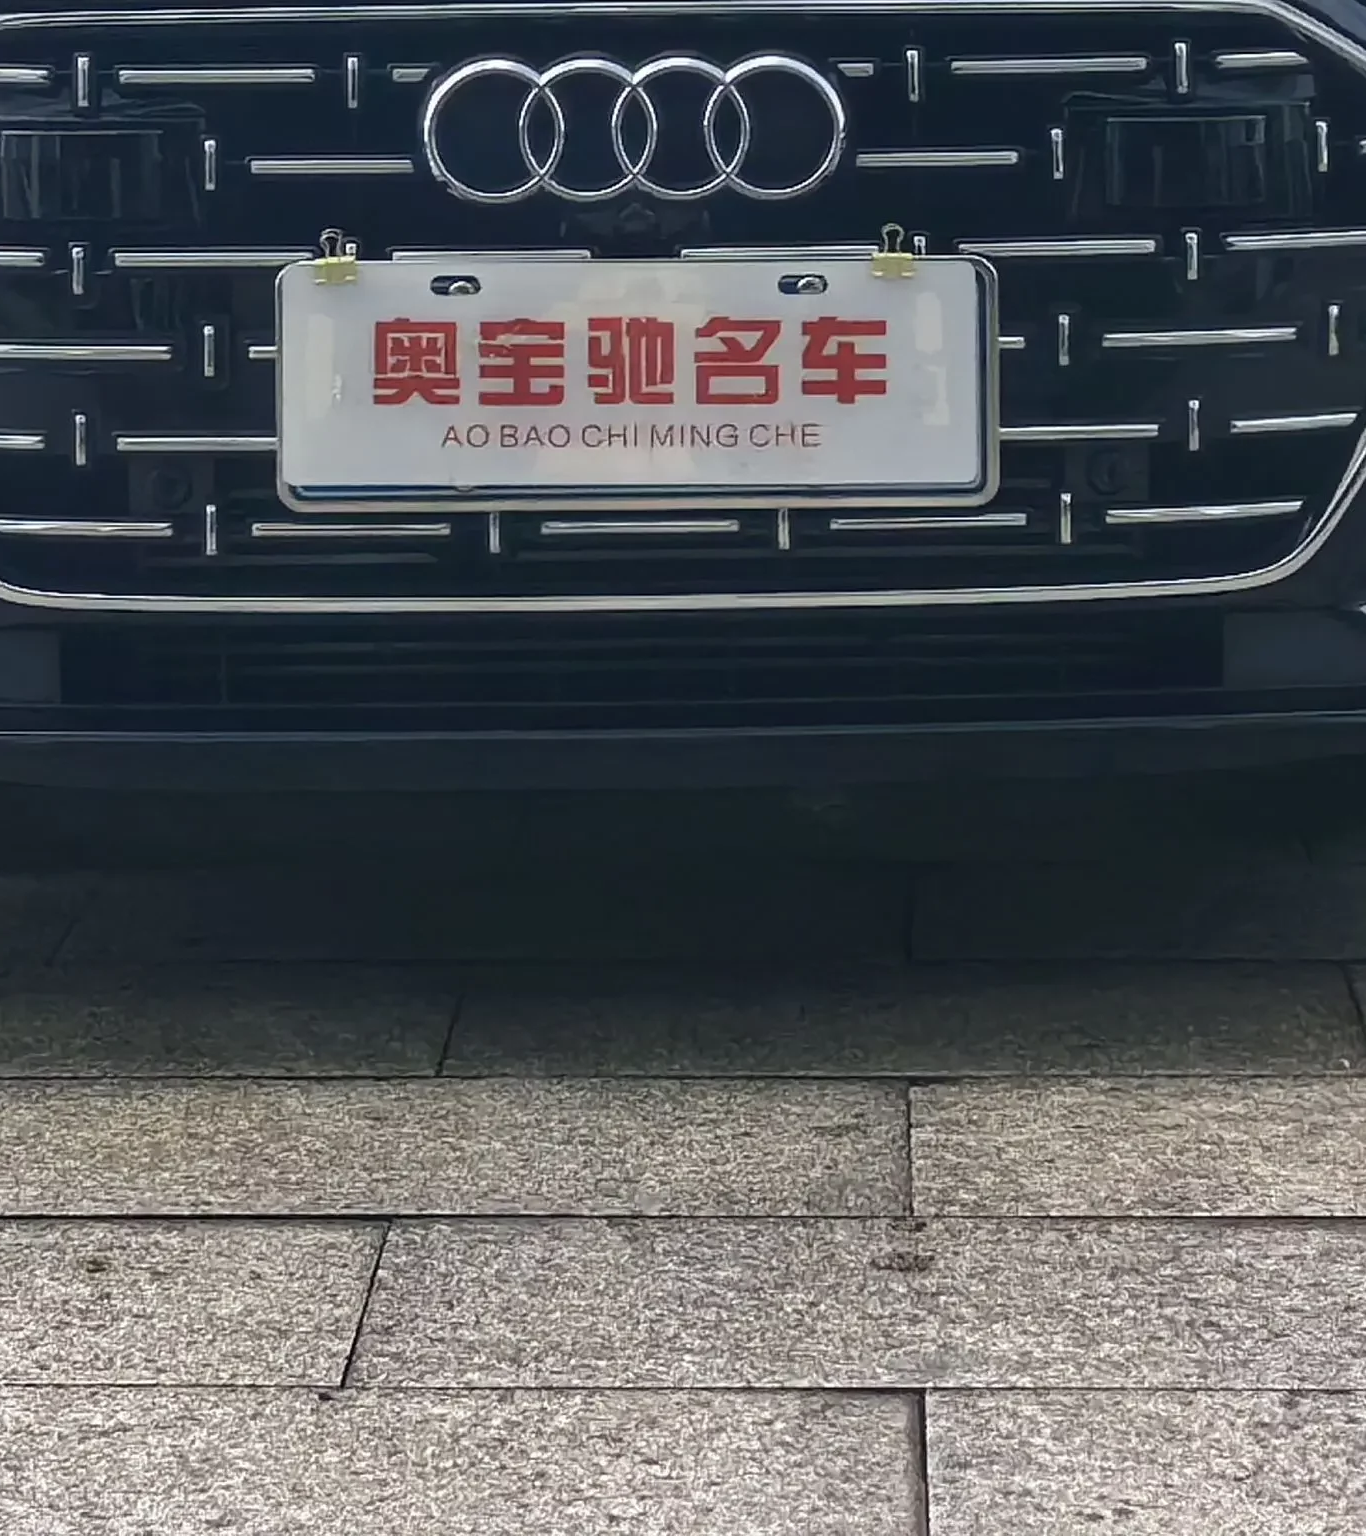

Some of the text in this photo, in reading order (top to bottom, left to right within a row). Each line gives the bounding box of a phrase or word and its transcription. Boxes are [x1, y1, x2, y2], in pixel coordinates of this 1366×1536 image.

[373, 317, 887, 405] 奥宝驰名车
[441, 423, 823, 448] AO BAO CHI MING CHE
